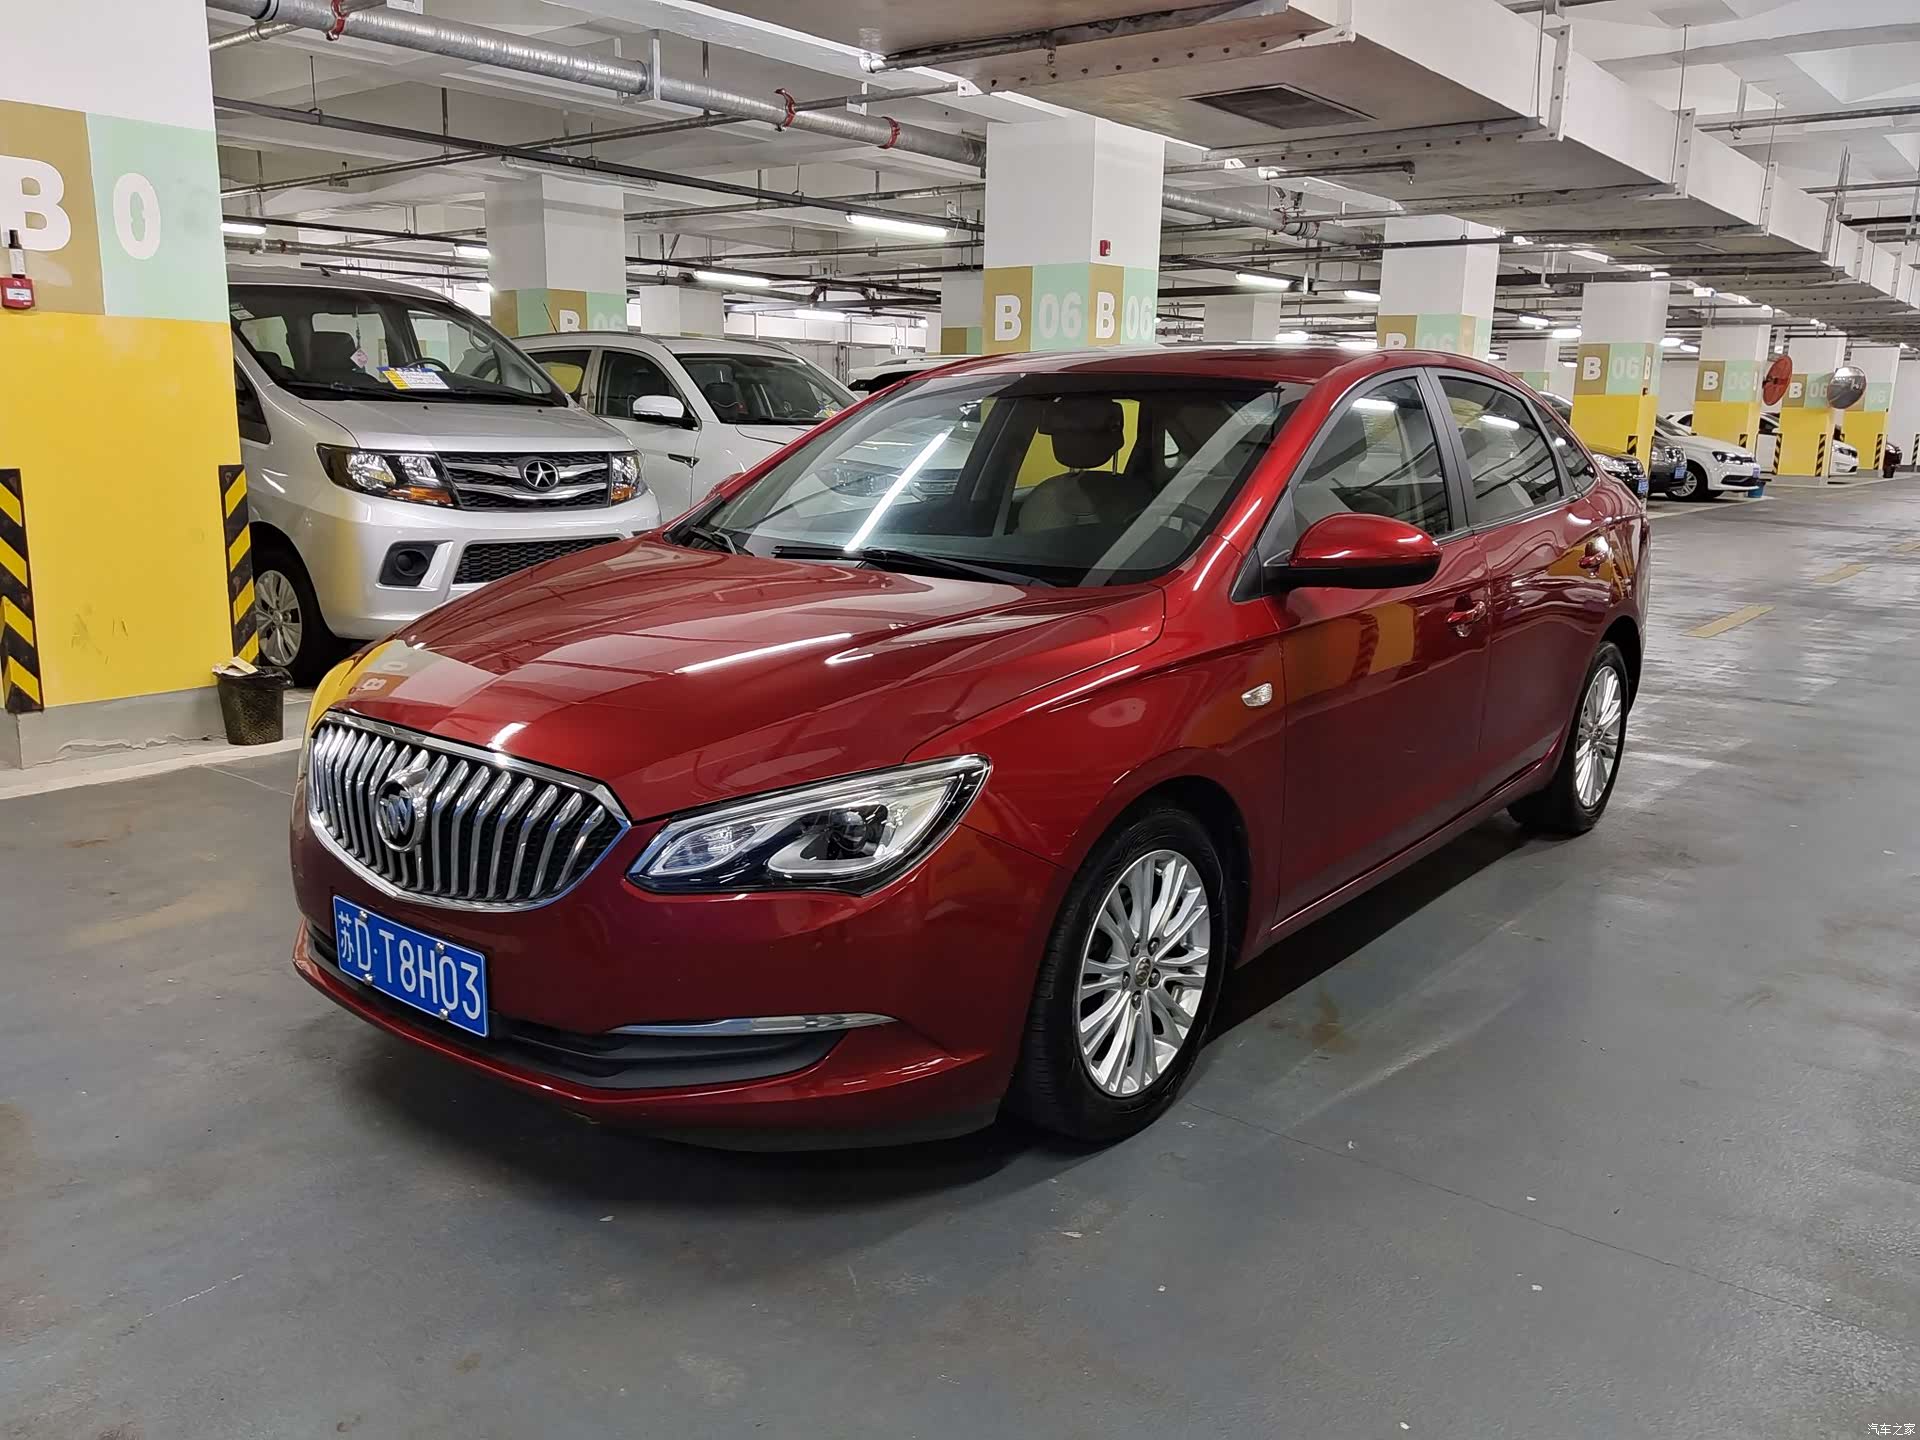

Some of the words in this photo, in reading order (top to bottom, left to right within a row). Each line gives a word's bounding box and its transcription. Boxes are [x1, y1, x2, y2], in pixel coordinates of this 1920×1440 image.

[0, 154, 72, 252] B
[113, 172, 161, 260] 0
[994, 294, 1022, 341] B
[1038, 292, 1082, 339] 06
[1095, 291, 1115, 339] B
[1125, 295, 1152, 341] 06
[1582, 356, 1602, 381] B
[1611, 356, 1640, 380] 06
[1702, 371, 1719, 391] B
[1788, 382, 1803, 399] B
